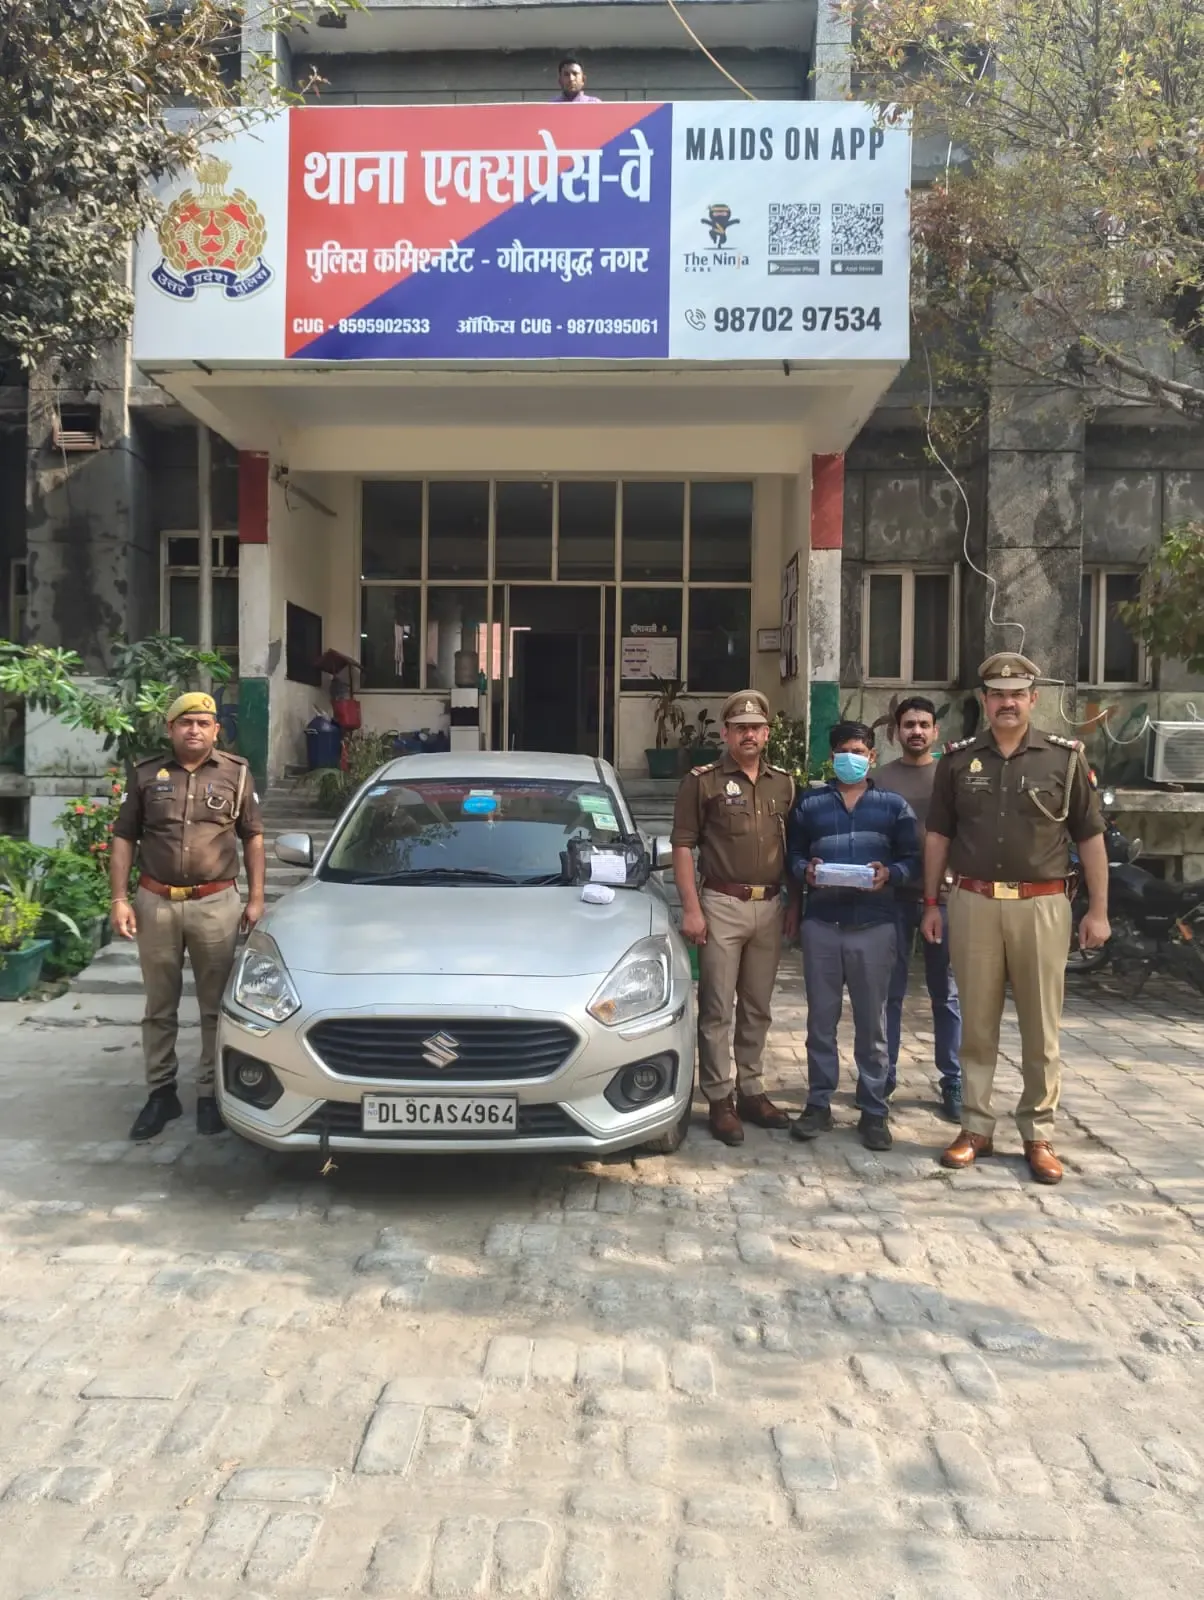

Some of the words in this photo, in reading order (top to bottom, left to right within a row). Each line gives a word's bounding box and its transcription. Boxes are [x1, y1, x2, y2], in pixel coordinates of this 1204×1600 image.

[686, 127, 773, 161] MAIDS
[785, 127, 819, 161] ON
[831, 127, 885, 160] APP
[303, 151, 408, 205] थाना
[421, 129, 654, 206] एक्सप्रेस-वे
[306, 240, 368, 283] पुलिस
[374, 239, 475, 274] कमिश्नरेट
[497, 239, 594, 282] गौतमबुद्ध
[600, 247, 650, 273] नगर
[683, 252, 709, 265] The
[713, 252, 749, 270] Ninja
[293, 319, 324, 334] CUG
[338, 318, 430, 334] 8595902533
[456, 316, 515, 334] ऑफिस
[521, 319, 552, 334] CUG
[567, 319, 658, 334] 9870395061
[714, 306, 793, 332] 98702
[802, 306, 882, 332] 97534
[378, 1103, 514, 1124] DL9CAS4964
